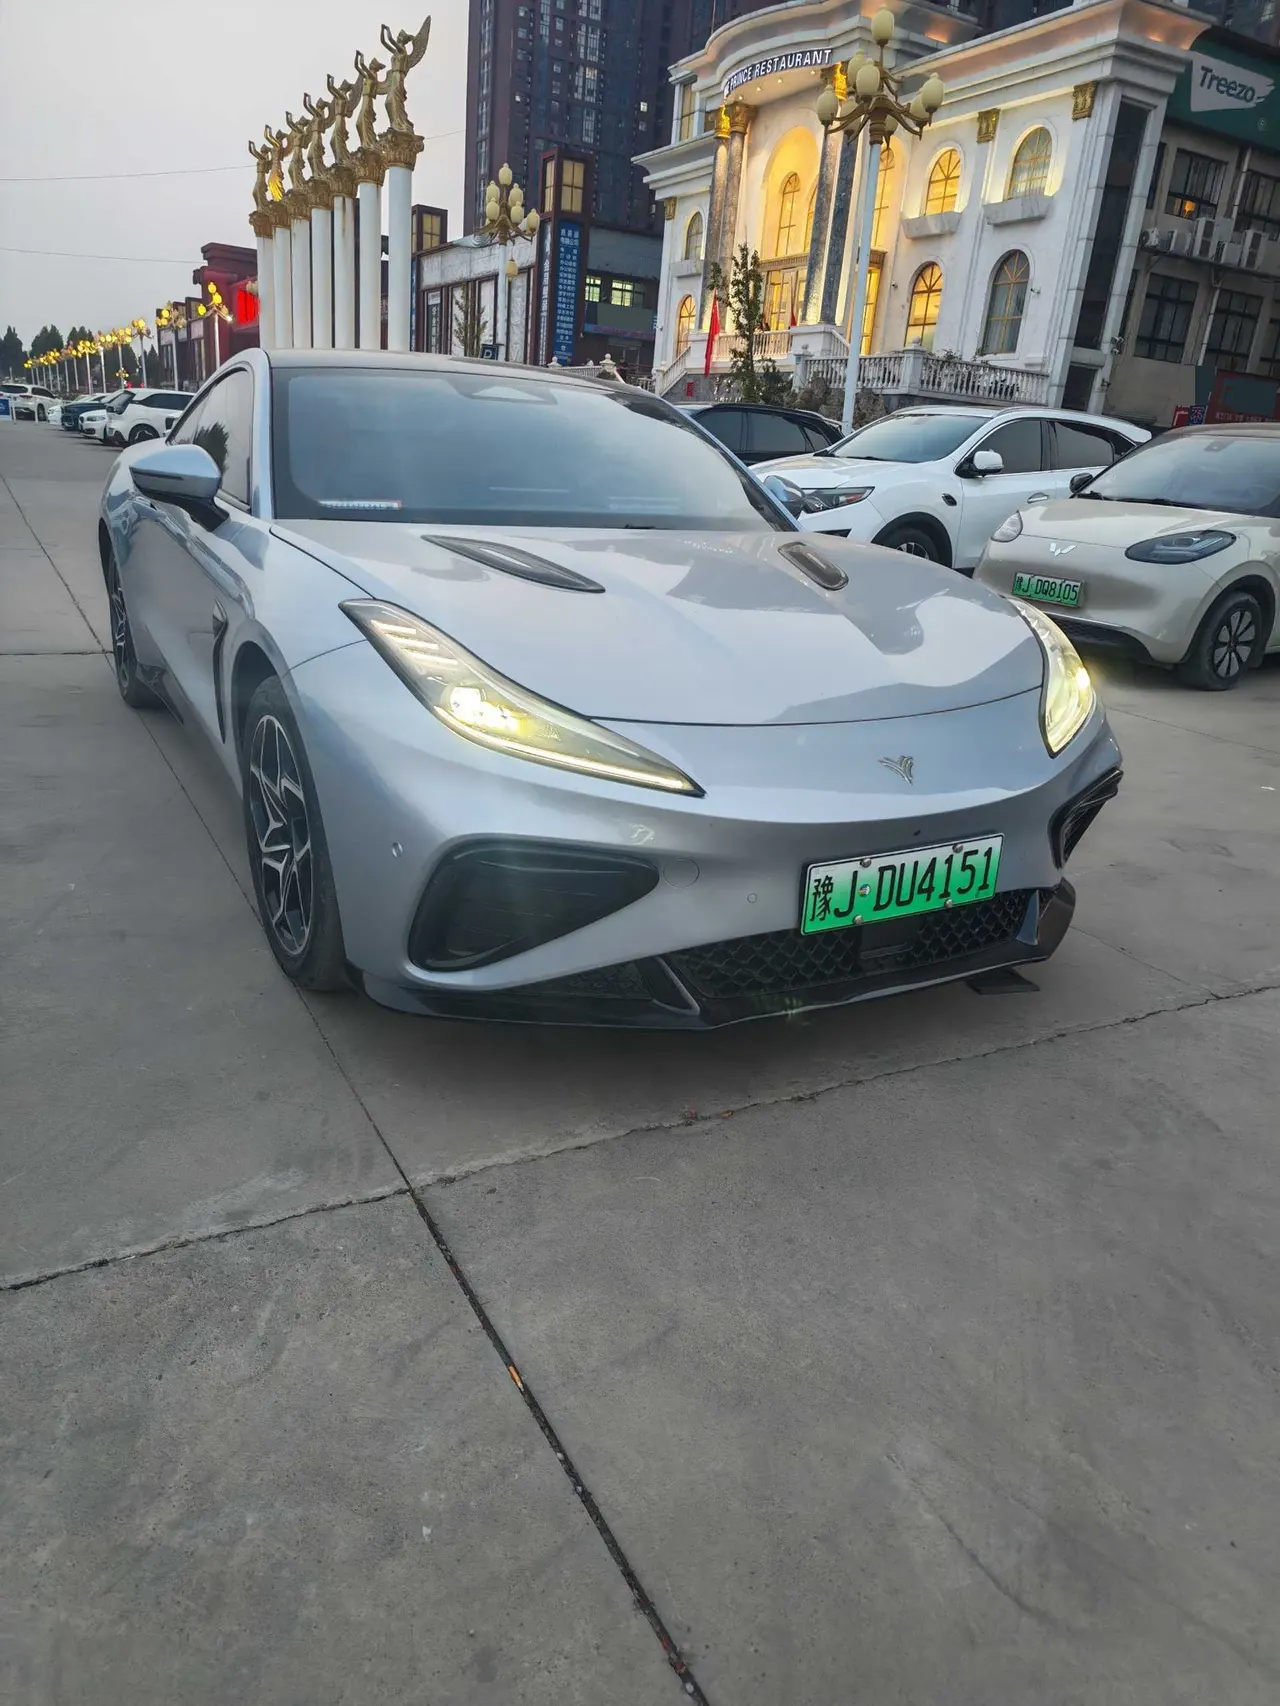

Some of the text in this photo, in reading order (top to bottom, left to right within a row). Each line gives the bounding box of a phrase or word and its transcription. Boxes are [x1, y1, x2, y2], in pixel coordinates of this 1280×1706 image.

[729, 66, 752, 91] PRINCE
[755, 49, 832, 77] RESTAURANT
[1199, 65, 1256, 103] Treezo
[1034, 578, 1079, 602] DQ8105
[872, 846, 993, 912] DU4151
